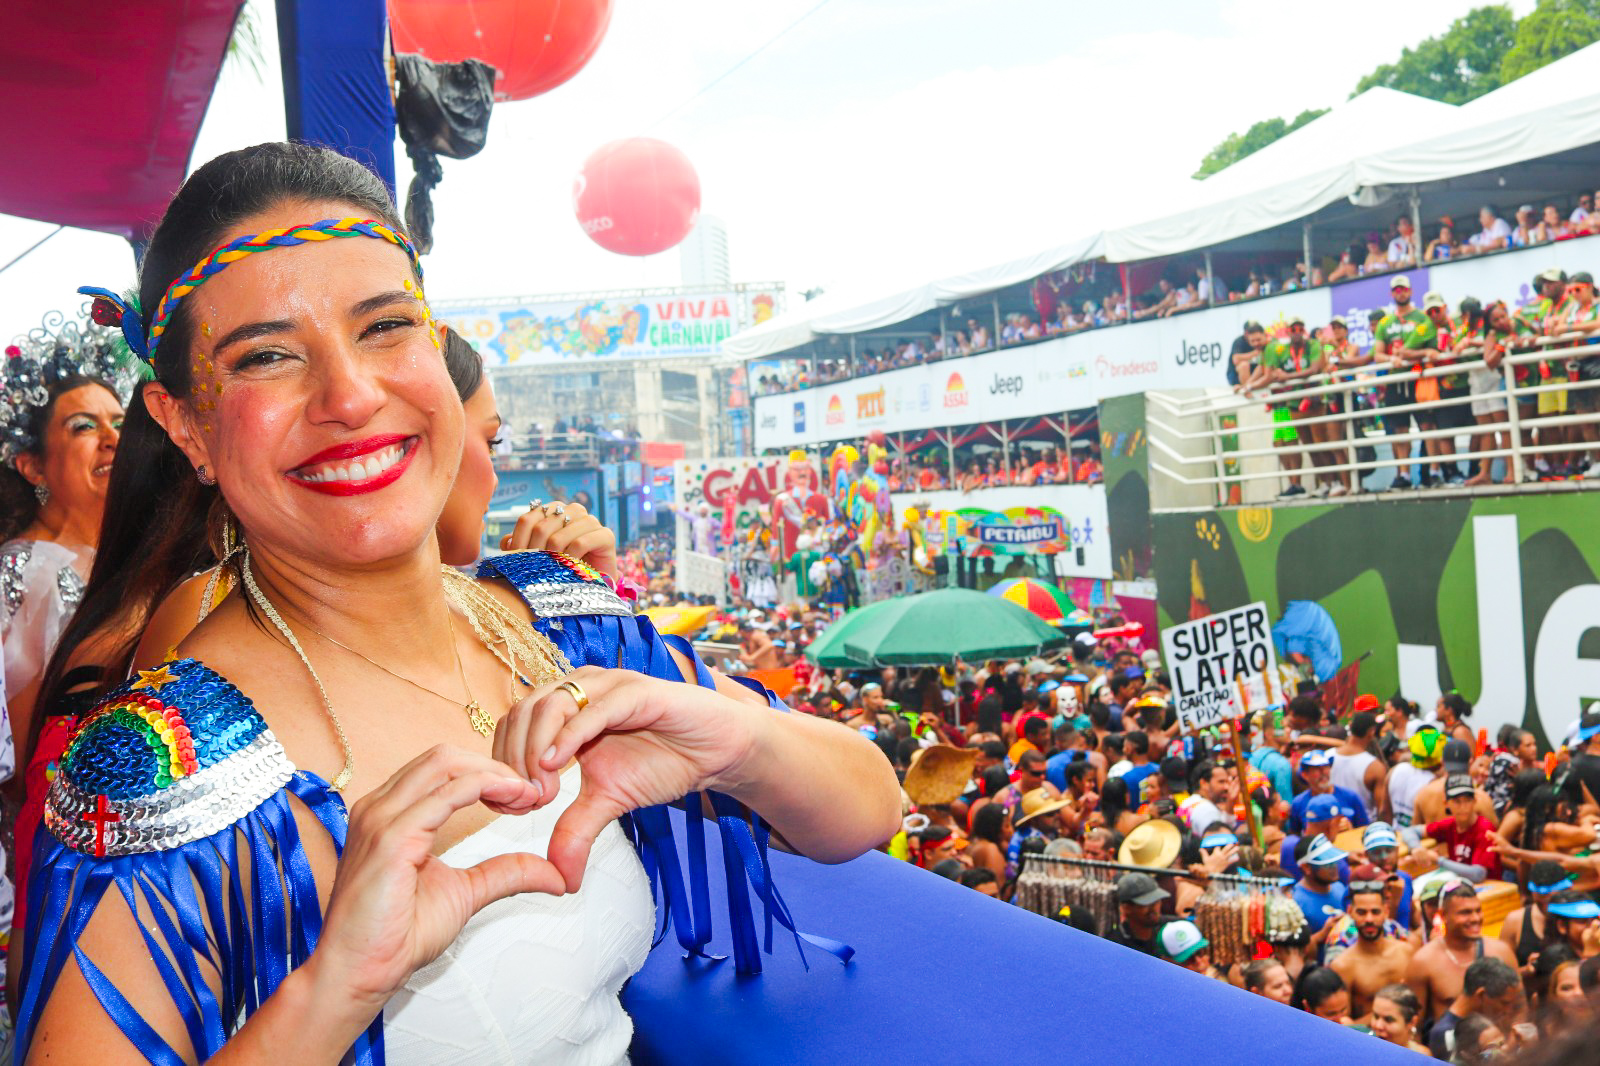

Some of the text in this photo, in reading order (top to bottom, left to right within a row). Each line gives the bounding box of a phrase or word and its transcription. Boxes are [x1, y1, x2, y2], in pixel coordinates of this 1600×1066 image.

[656, 297, 731, 321] VIVA
[1175, 339, 1222, 368] Jeep
[1111, 358, 1158, 377] bradesco
[989, 373, 1023, 397] Jeep
[1173, 608, 1266, 660] SUPER
[1175, 643, 1268, 696] LATÃO
[1179, 688, 1230, 712] CARTÃO
[1182, 714, 1191, 728] E
